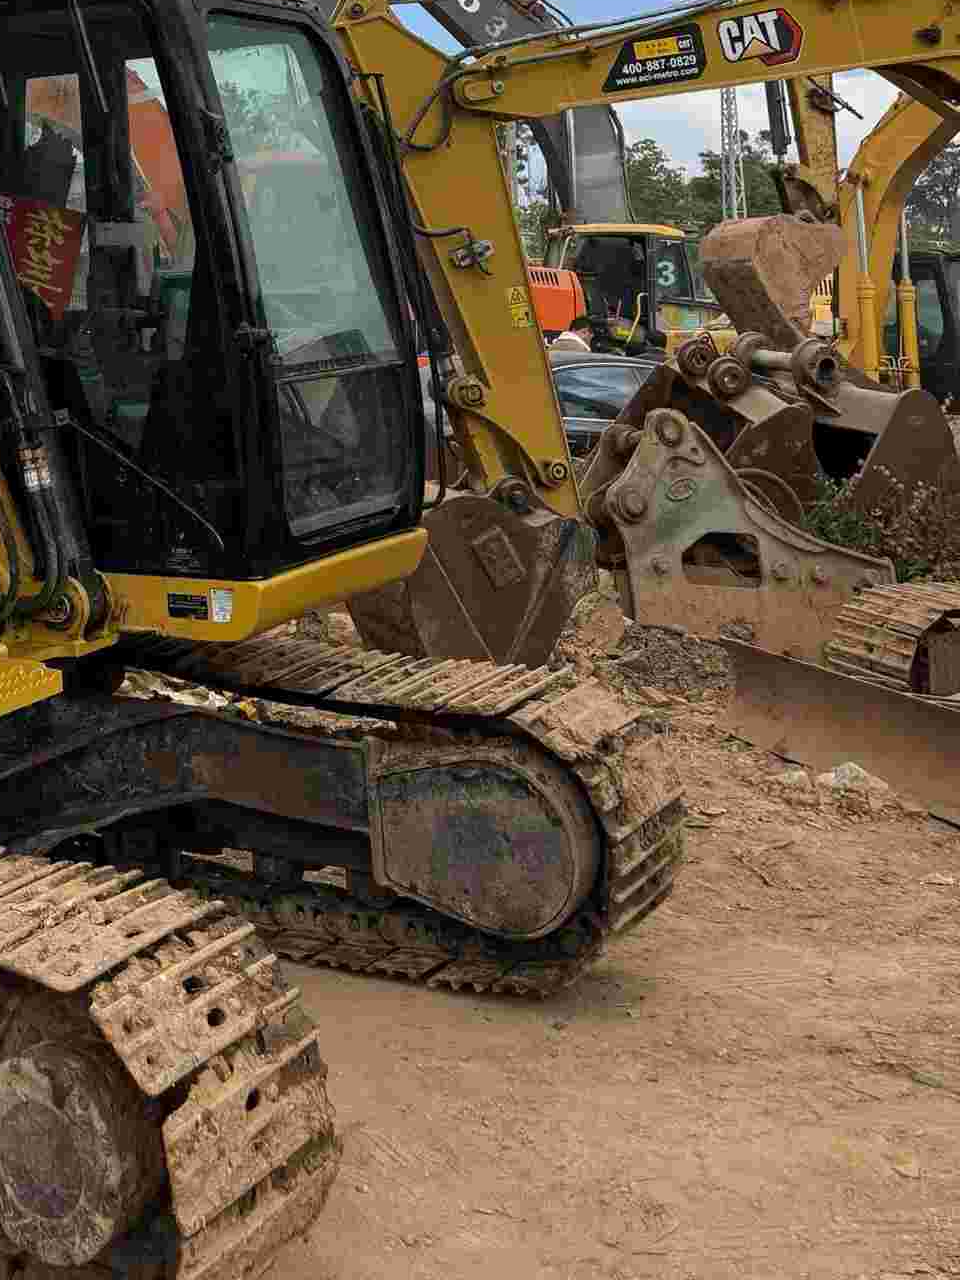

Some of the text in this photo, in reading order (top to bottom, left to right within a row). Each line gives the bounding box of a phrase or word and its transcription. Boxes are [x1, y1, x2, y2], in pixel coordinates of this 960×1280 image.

[720, 11, 780, 62] CAT
[622, 54, 697, 75] 400-887-0829
[657, 260, 675, 286] 3
